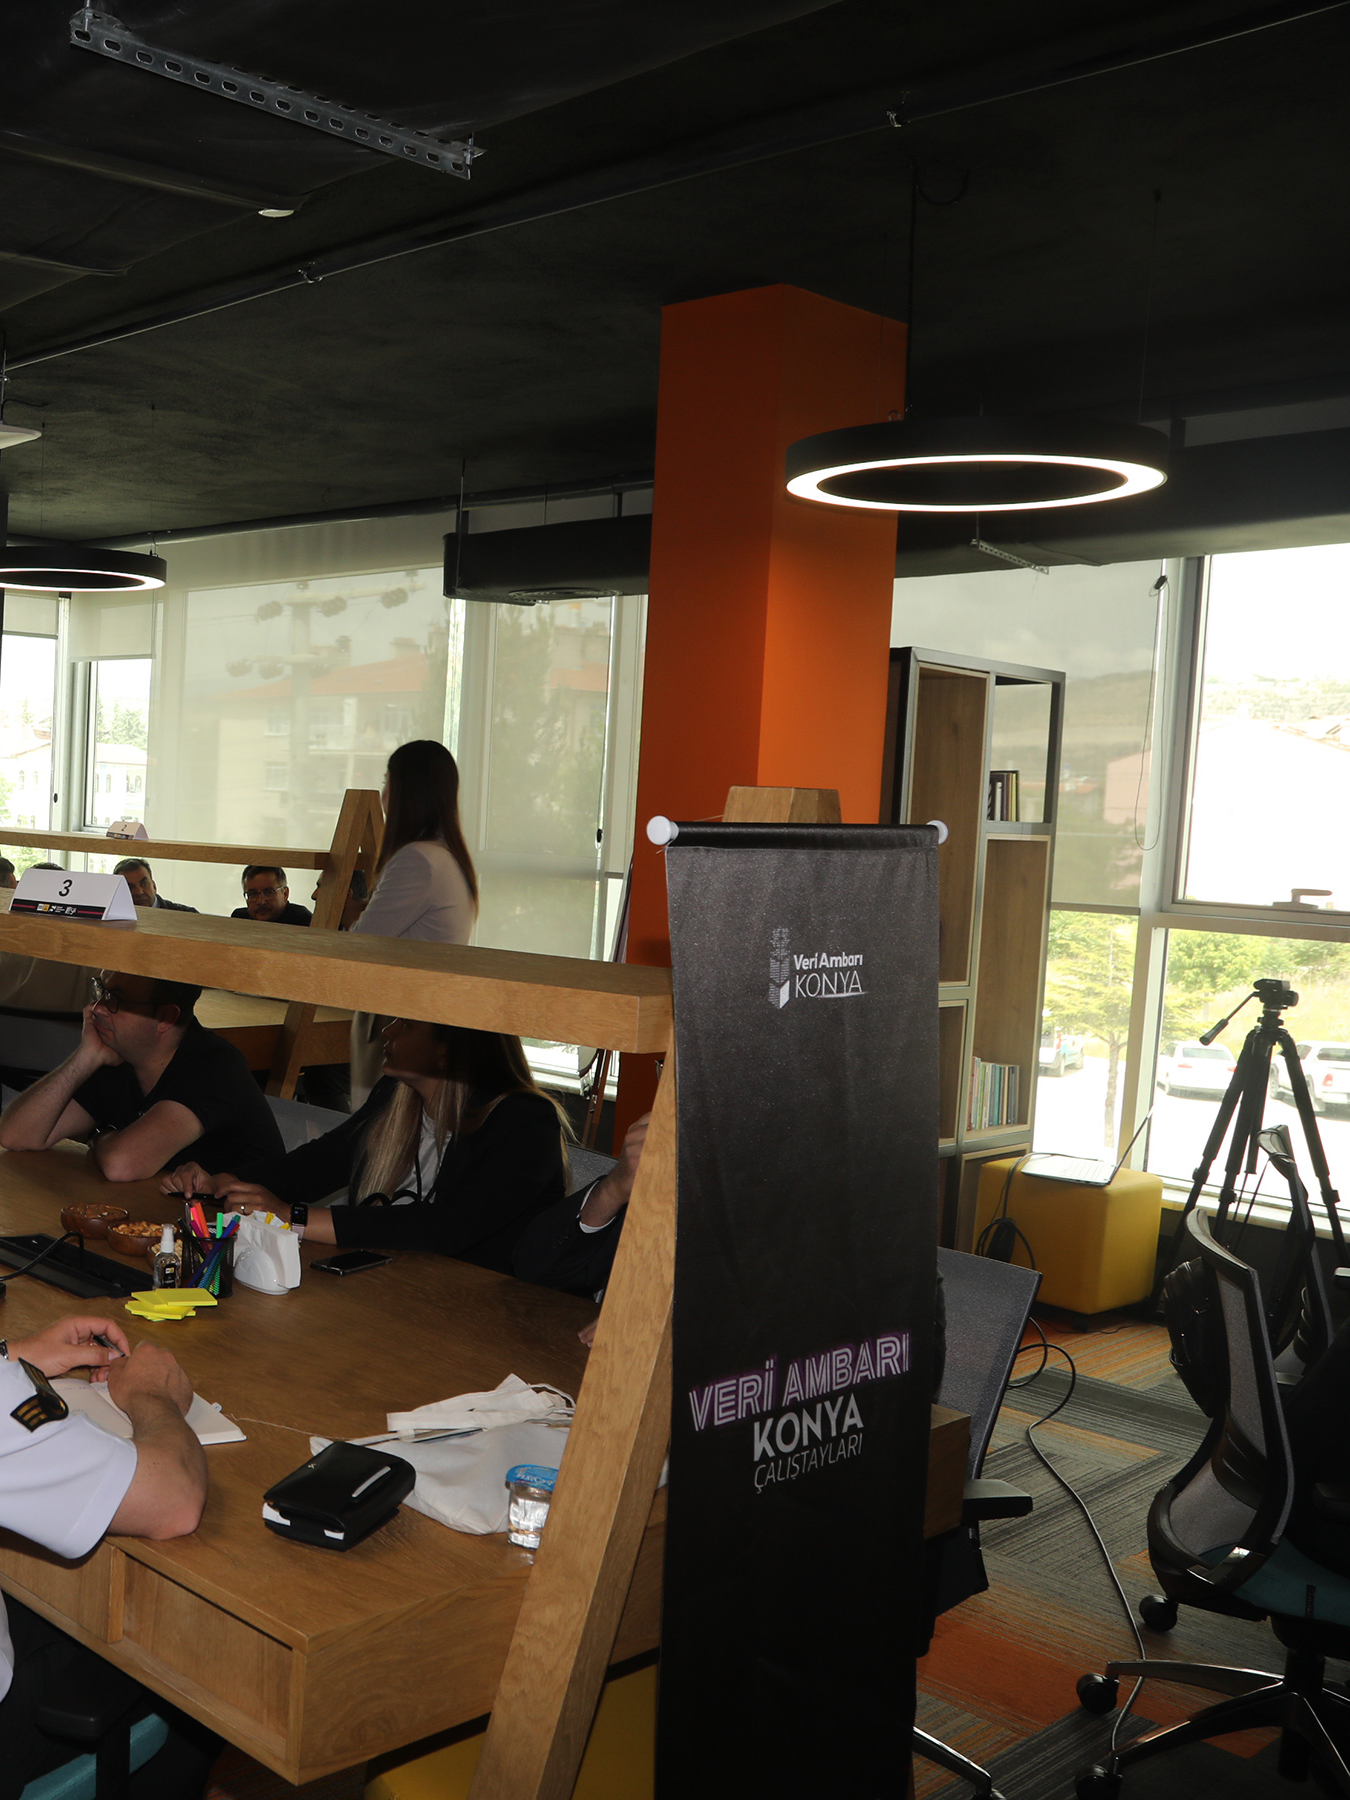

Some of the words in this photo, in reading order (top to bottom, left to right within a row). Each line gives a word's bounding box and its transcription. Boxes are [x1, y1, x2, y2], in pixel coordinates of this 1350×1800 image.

[58, 879, 73, 897] 3
[793, 952, 818, 970] Veri
[818, 952, 863, 969] Ambarı
[795, 970, 863, 998] KONYA
[689, 1359, 775, 1432] VERİ
[782, 1333, 910, 1407] AMBARI
[753, 1392, 864, 1462] KONYA
[754, 1433, 864, 1494] ÇALIŞTAYLARI
